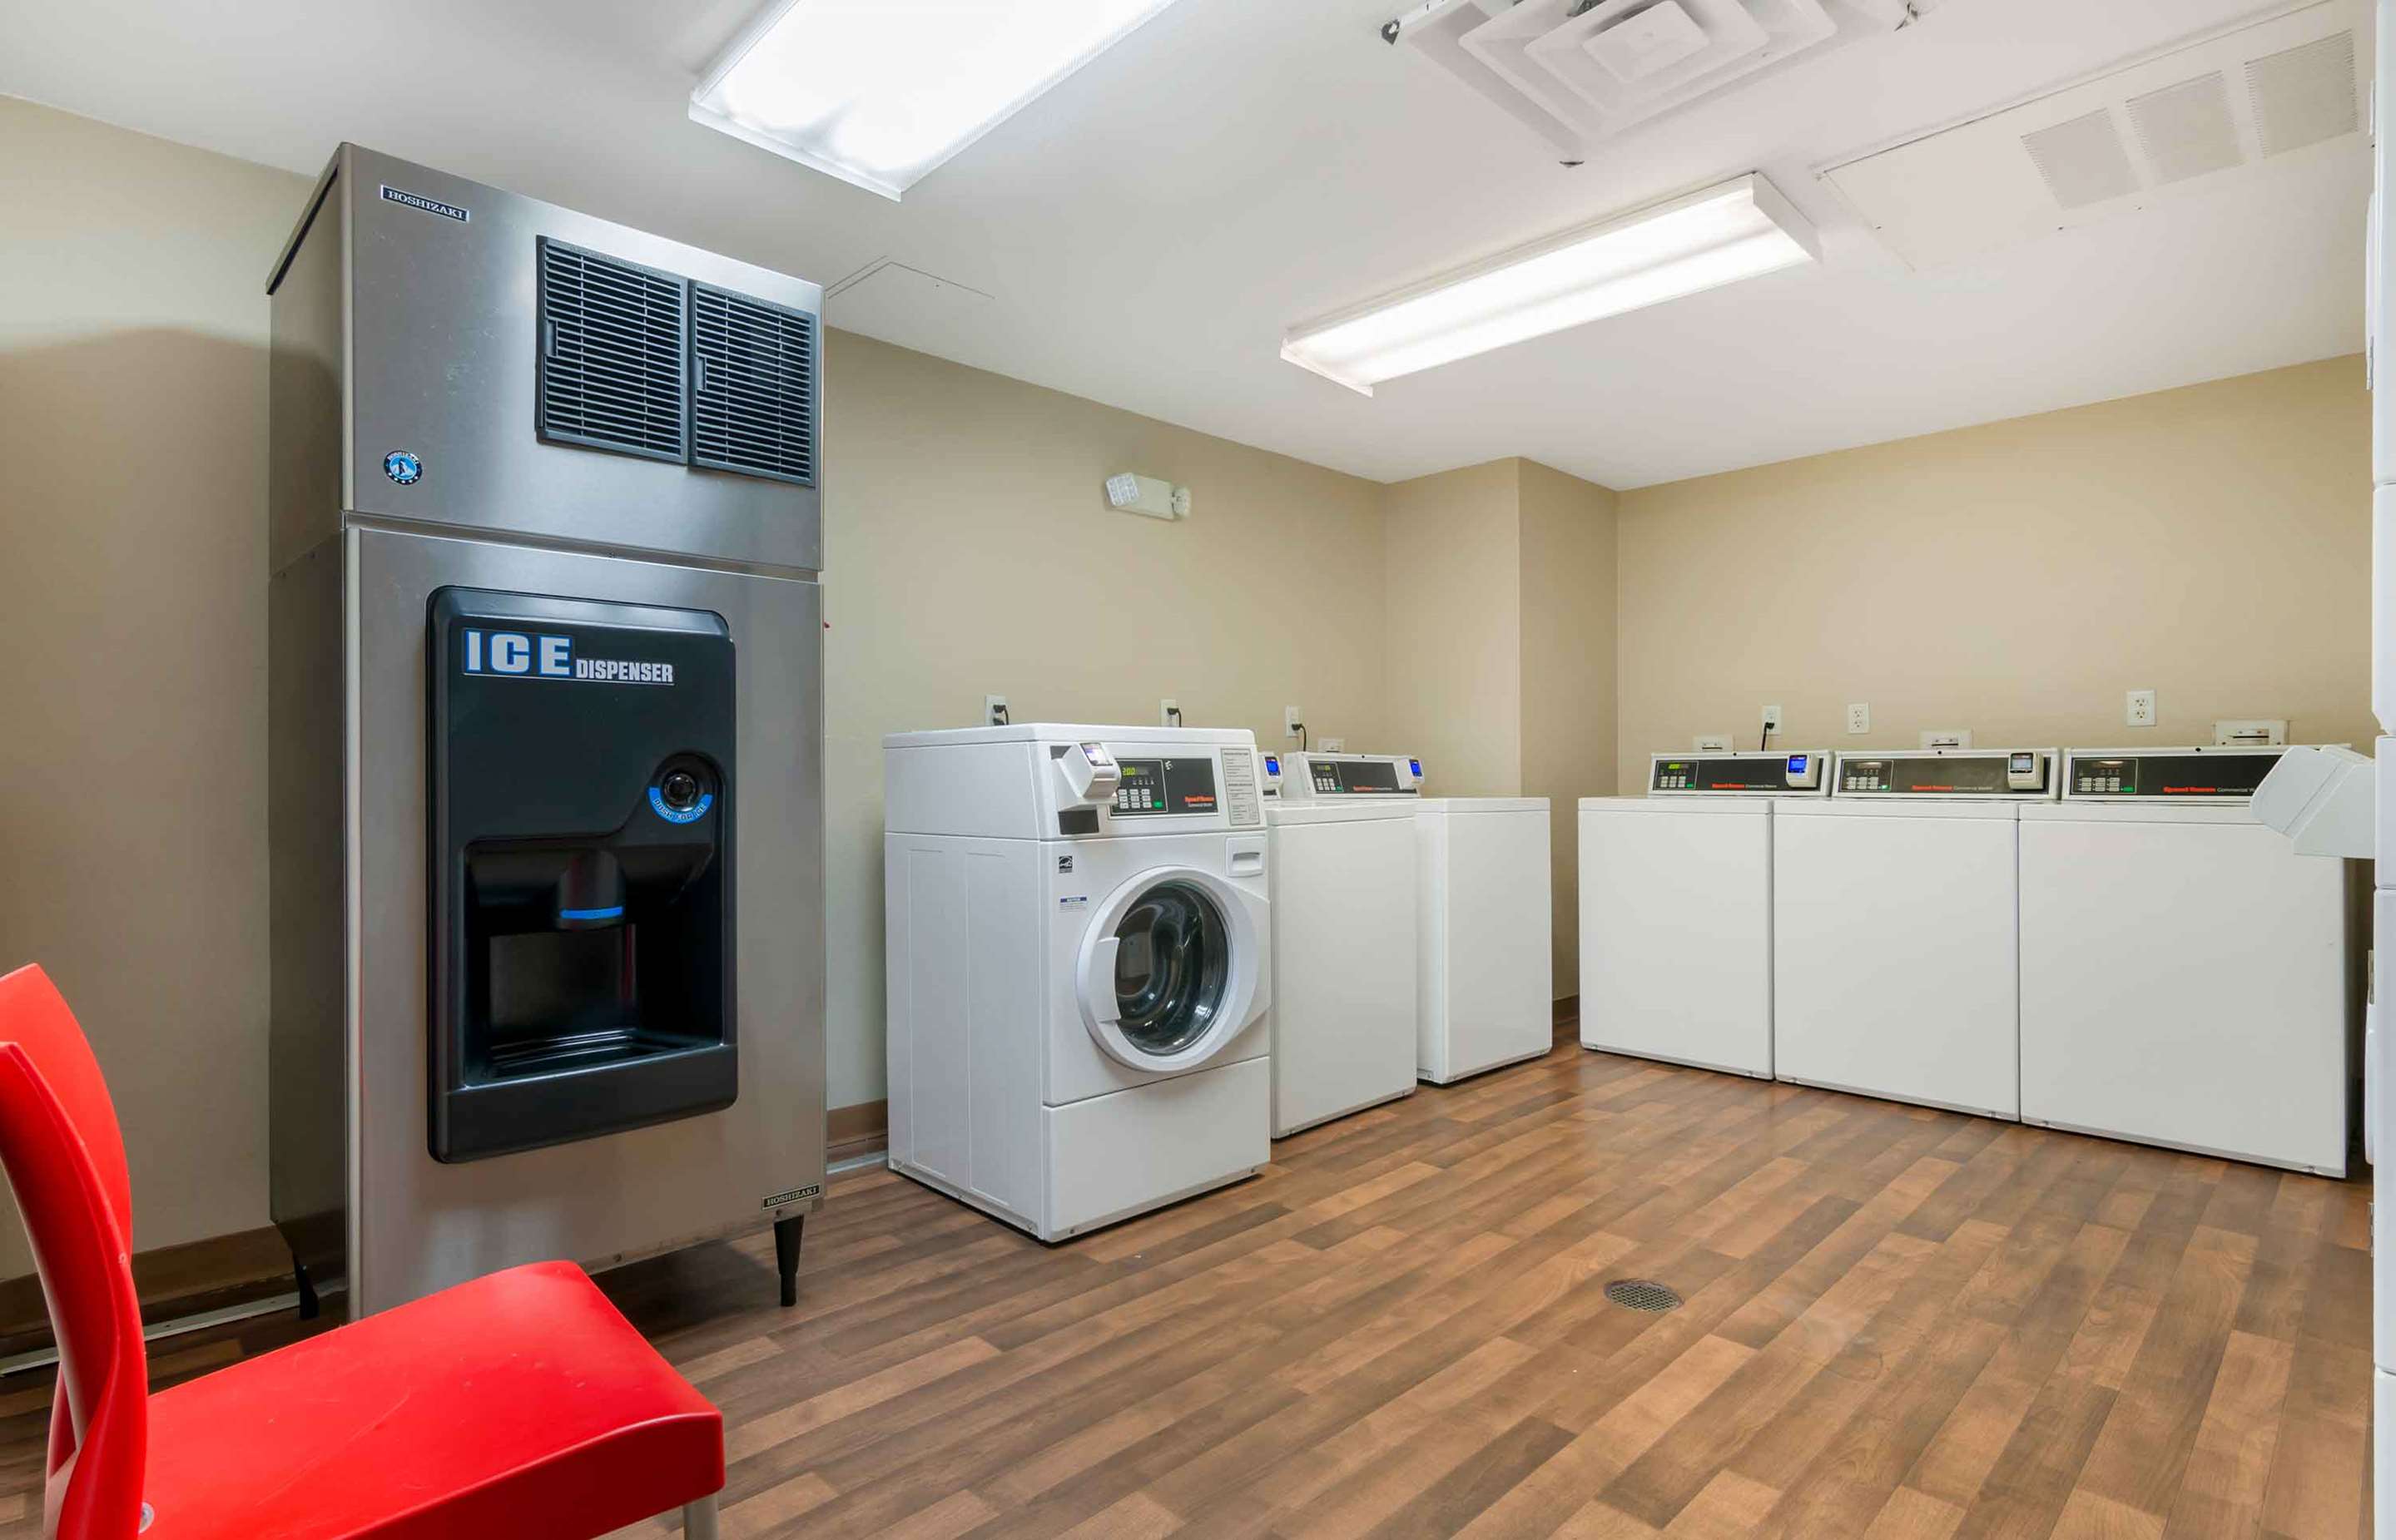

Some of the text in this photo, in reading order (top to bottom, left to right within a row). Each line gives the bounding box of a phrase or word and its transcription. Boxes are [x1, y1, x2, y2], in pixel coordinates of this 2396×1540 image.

[387, 190, 464, 219] HOSHIZAKI
[465, 631, 673, 682] ICE DISPENSER
[766, 1186, 816, 1206] HOSHIZAKI
